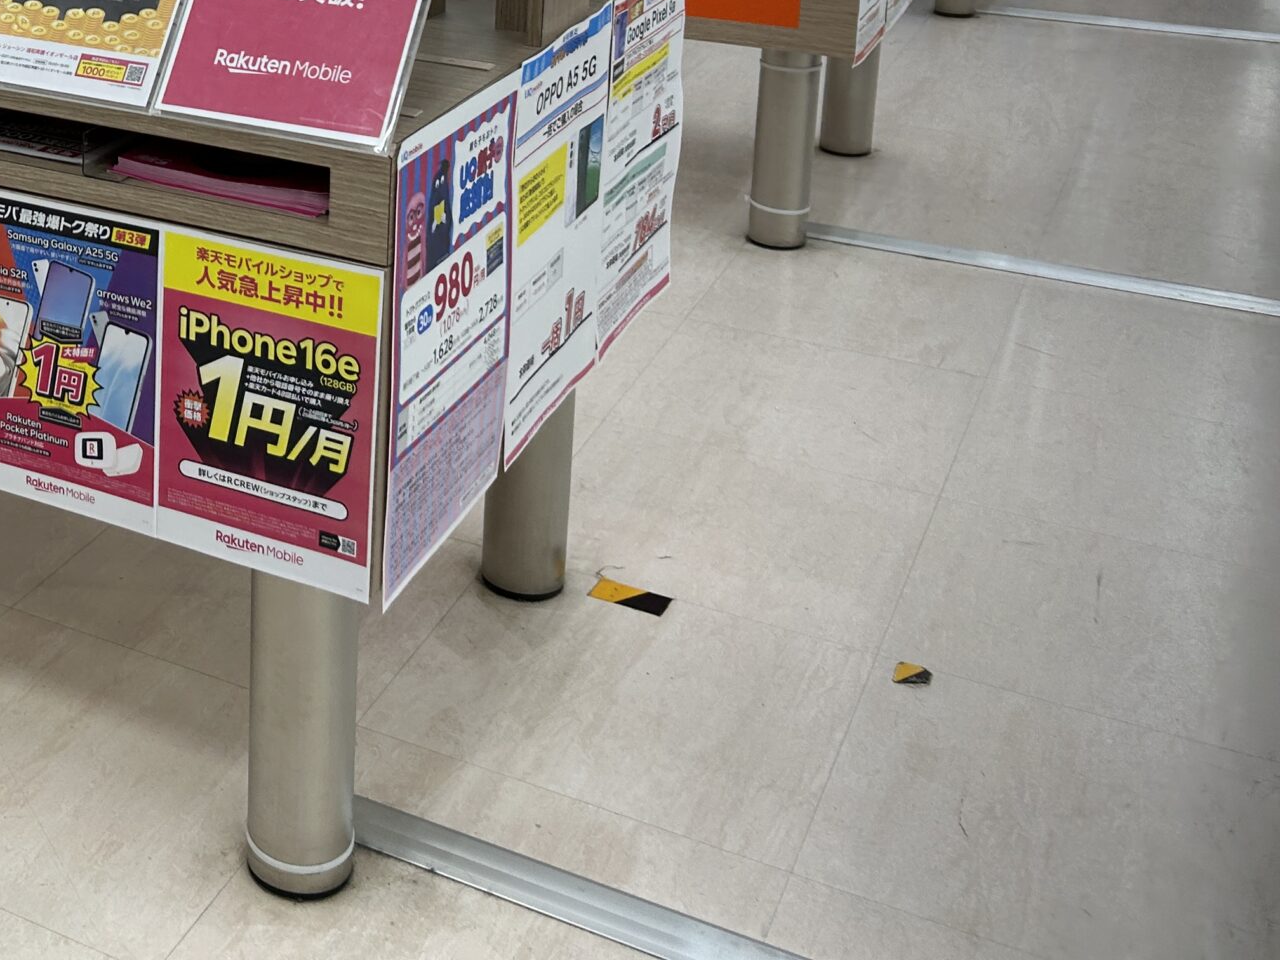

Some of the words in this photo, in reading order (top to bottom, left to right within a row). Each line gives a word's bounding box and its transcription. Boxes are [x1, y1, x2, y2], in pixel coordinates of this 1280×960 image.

[626, 16, 651, 45] Google
[651, 5, 668, 31] Pixel
[81, 65, 106, 77] 1000
[213, 48, 292, 76] Rakuten
[292, 59, 353, 84] Mobile
[535, 75, 565, 116] OPPO
[566, 65, 580, 88] A5
[581, 54, 598, 83] 5G
[19, 209, 111, 240] 最強爆トク祭り
[114, 229, 148, 247] 第3弾
[7, 229, 50, 248] Samsung
[50, 237, 84, 256] Galaxy
[84, 247, 105, 260] A25
[104, 249, 119, 263] 5G
[10, 268, 28, 281] S2R
[195, 246, 345, 292] 楽天モバイルショップで
[96, 289, 130, 305] arrows
[130, 294, 153, 310] We2
[195, 267, 345, 319] 人気急上昇中!!
[62, 346, 96, 359] 大特価!!
[179, 305, 298, 367] iPhone
[298, 340, 362, 382] 16e
[31, 341, 86, 403] 1円
[246, 365, 315, 388] 楽天モバイルお申し込み
[319, 374, 357, 395] (128GB)
[6, 411, 43, 430] Rakuten
[183, 409, 202, 422] 価格
[184, 398, 202, 413] 衝撃
[198, 354, 352, 475] 1円/月
[0, 421, 30, 437] Pocket
[29, 428, 70, 448] Platinum
[25, 474, 66, 496] Rakuten
[65, 488, 96, 505] Mobile
[215, 528, 265, 554] Rakuten
[266, 542, 304, 566] Mobile
